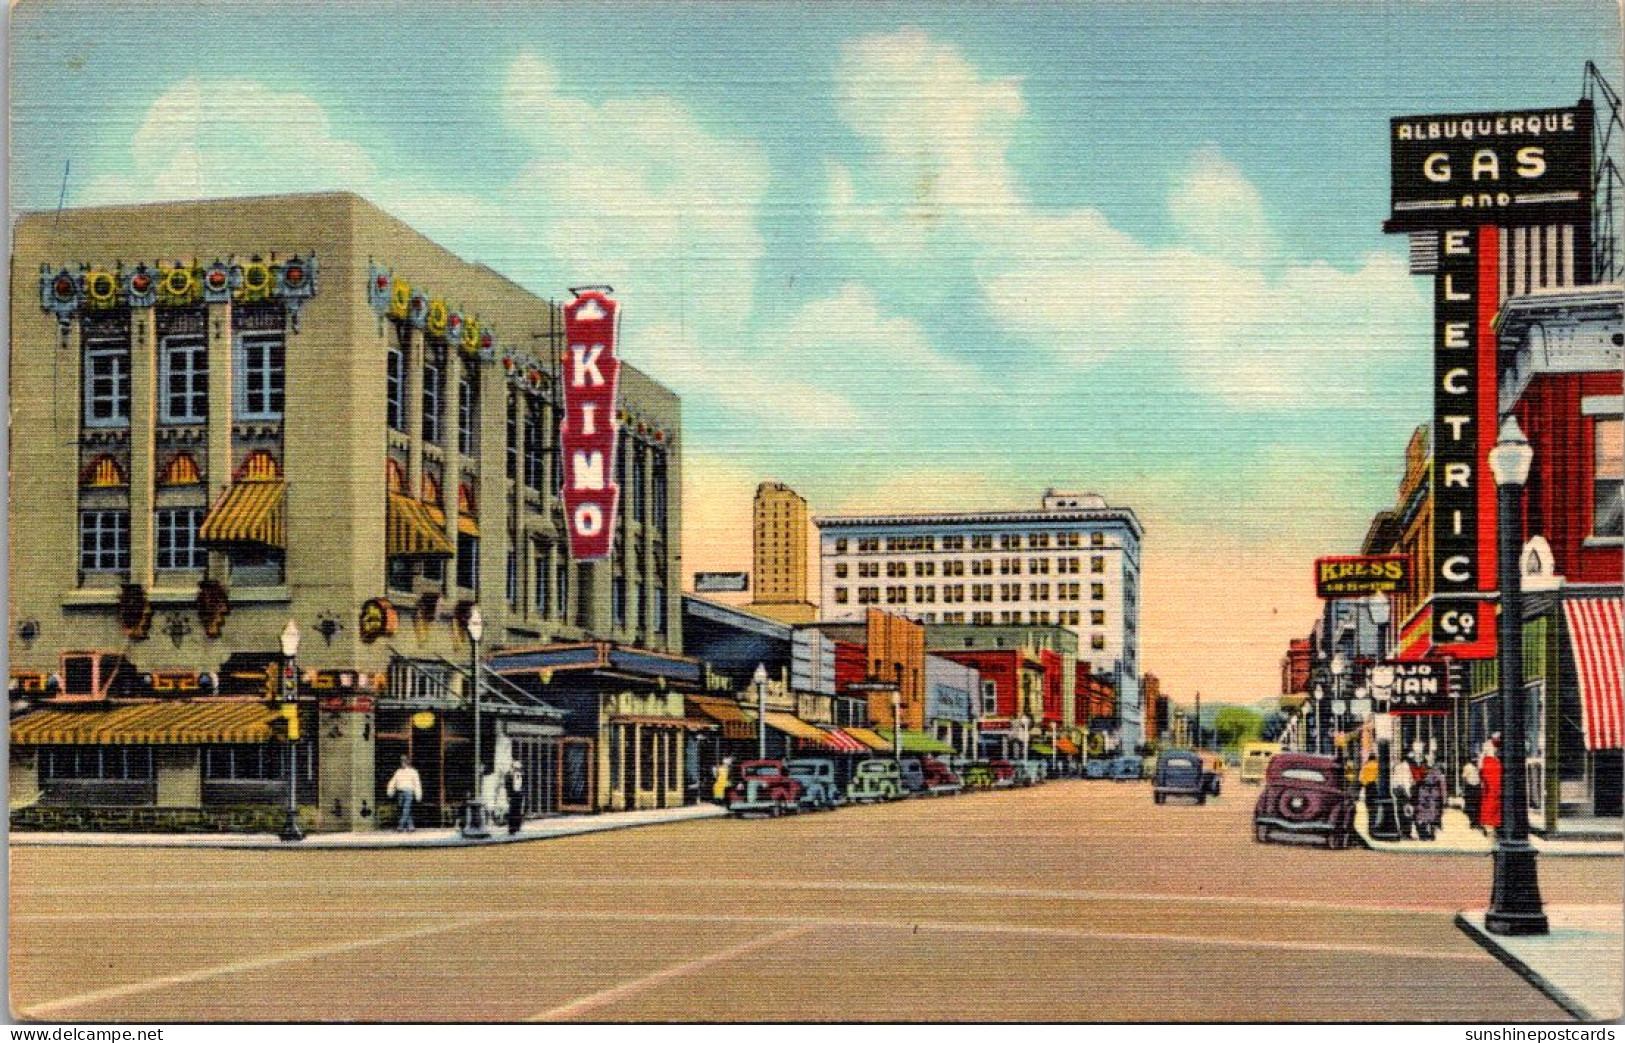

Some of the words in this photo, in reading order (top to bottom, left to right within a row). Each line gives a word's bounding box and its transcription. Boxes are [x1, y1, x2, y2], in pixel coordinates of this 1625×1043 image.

[1399, 113, 1574, 140] ALBUQUERQUE
[1423, 147, 1546, 182] GAS
[1443, 231, 1471, 582] ELECTRIC
[571, 344, 605, 536] KIMO
[1320, 562, 1402, 580] KRESS
